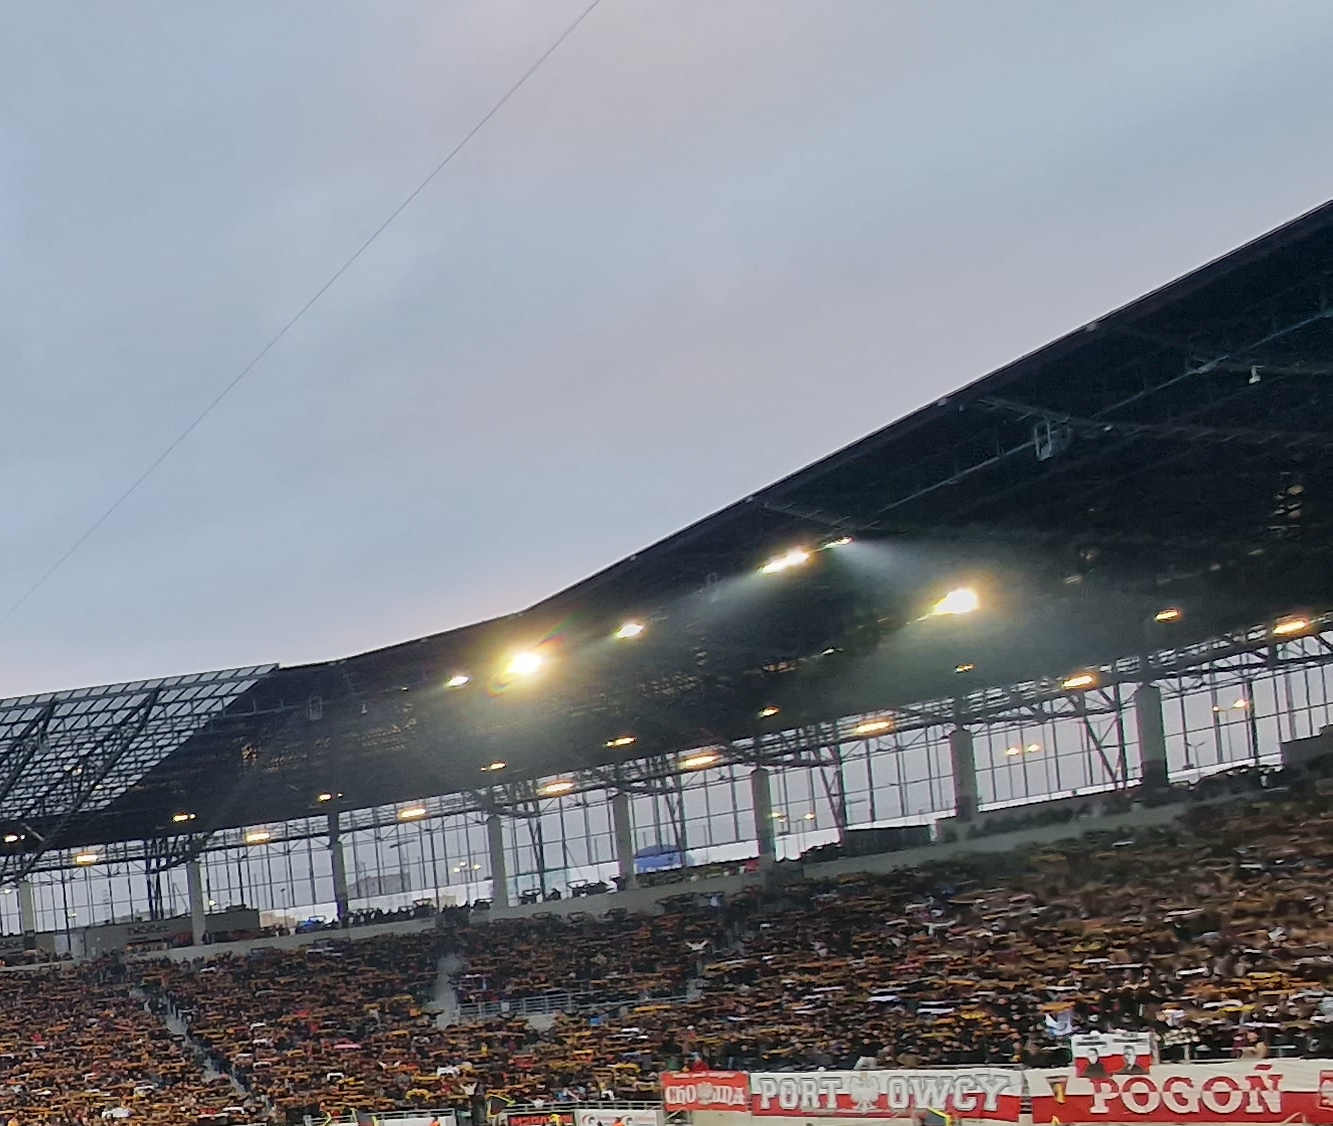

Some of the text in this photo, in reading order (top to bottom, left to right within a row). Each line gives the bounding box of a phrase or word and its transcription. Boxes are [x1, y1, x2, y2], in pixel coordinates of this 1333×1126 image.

[759, 1074, 1012, 1112] PORT OWCY
[1089, 1064, 1283, 1114] POGOŃ
